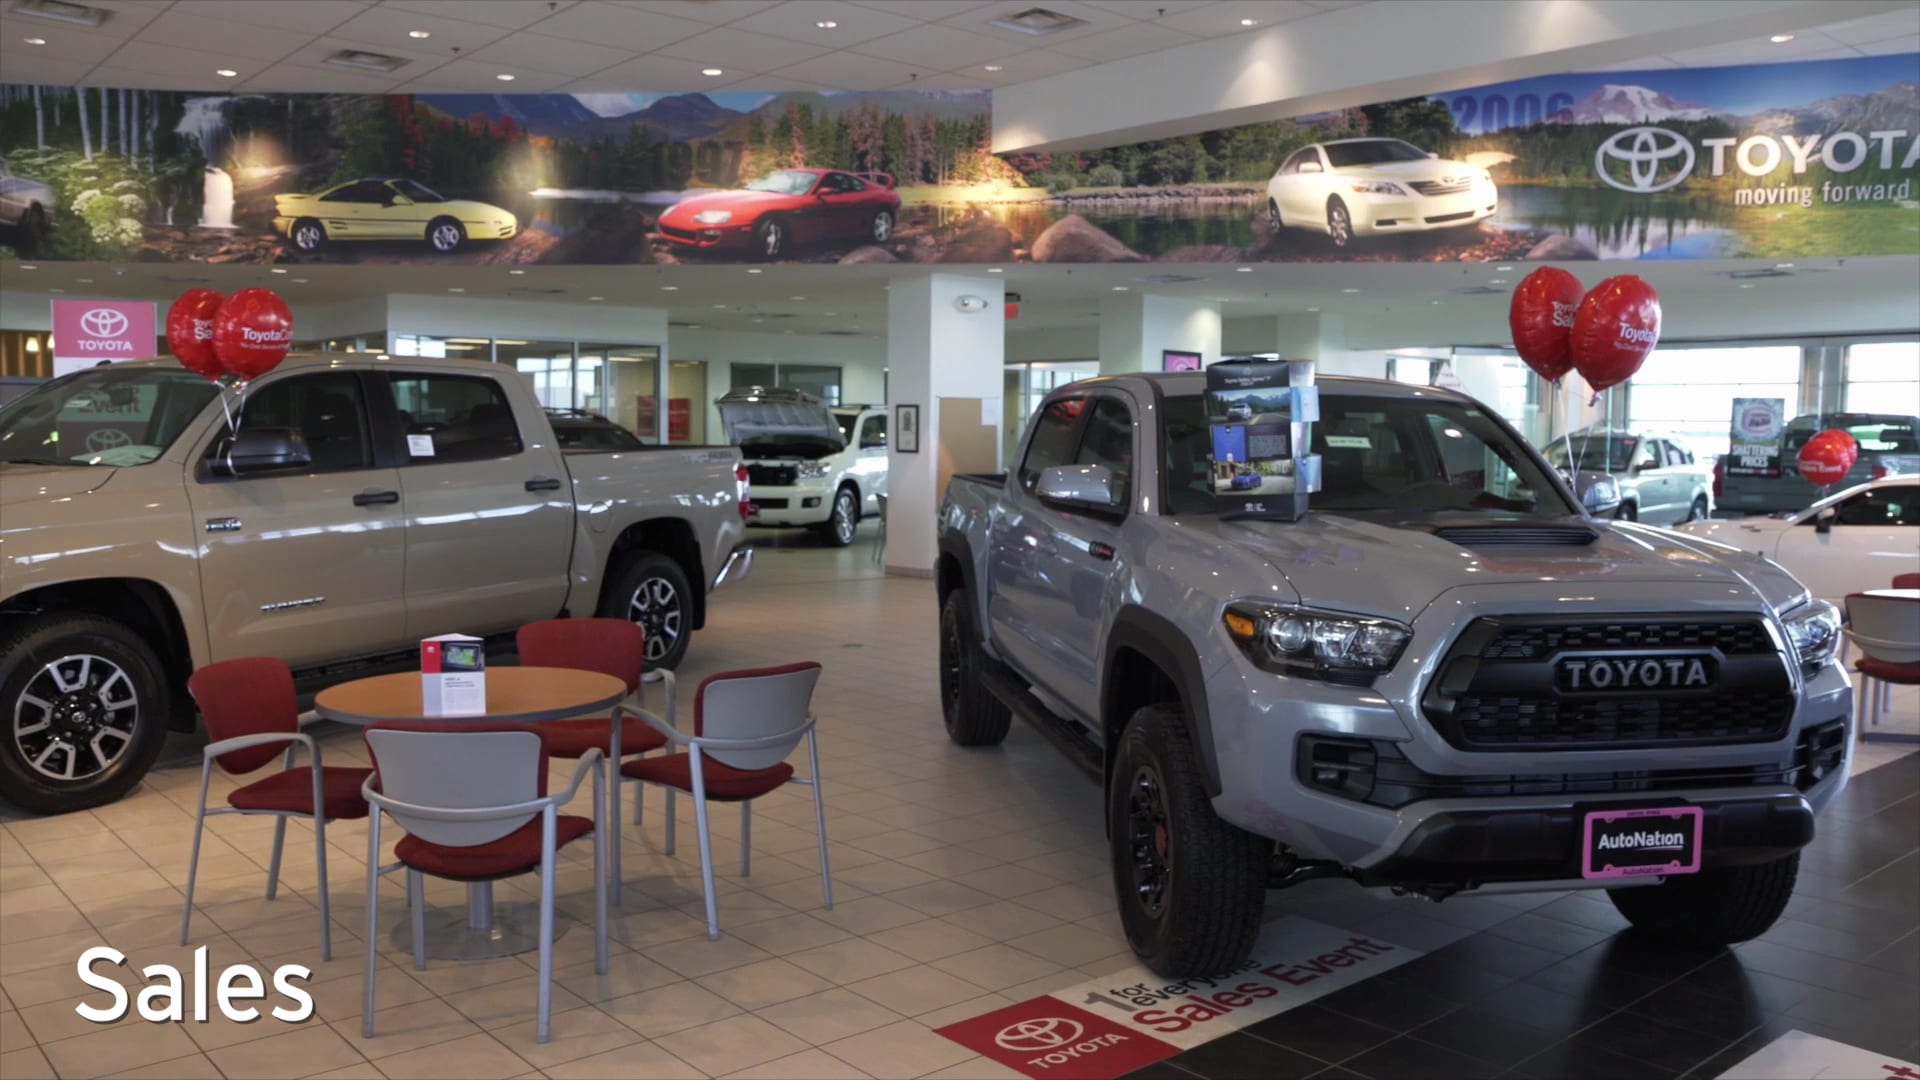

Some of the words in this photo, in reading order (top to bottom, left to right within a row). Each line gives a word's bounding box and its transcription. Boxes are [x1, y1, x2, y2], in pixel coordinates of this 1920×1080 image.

[1453, 92, 1574, 134] 2006
[1735, 182, 1814, 208] moving
[1822, 178, 1910, 203] forward
[77, 340, 133, 352] TOYOTA
[1619, 322, 1655, 343] Toyota
[1566, 658, 1708, 688] TOYOTA
[1598, 831, 1684, 850] AutoNation
[1110, 982, 1150, 998] for
[1133, 980, 1278, 1033] Sales
[1258, 935, 1396, 986] Event
[1027, 1033, 1129, 1069] TOYOTA
